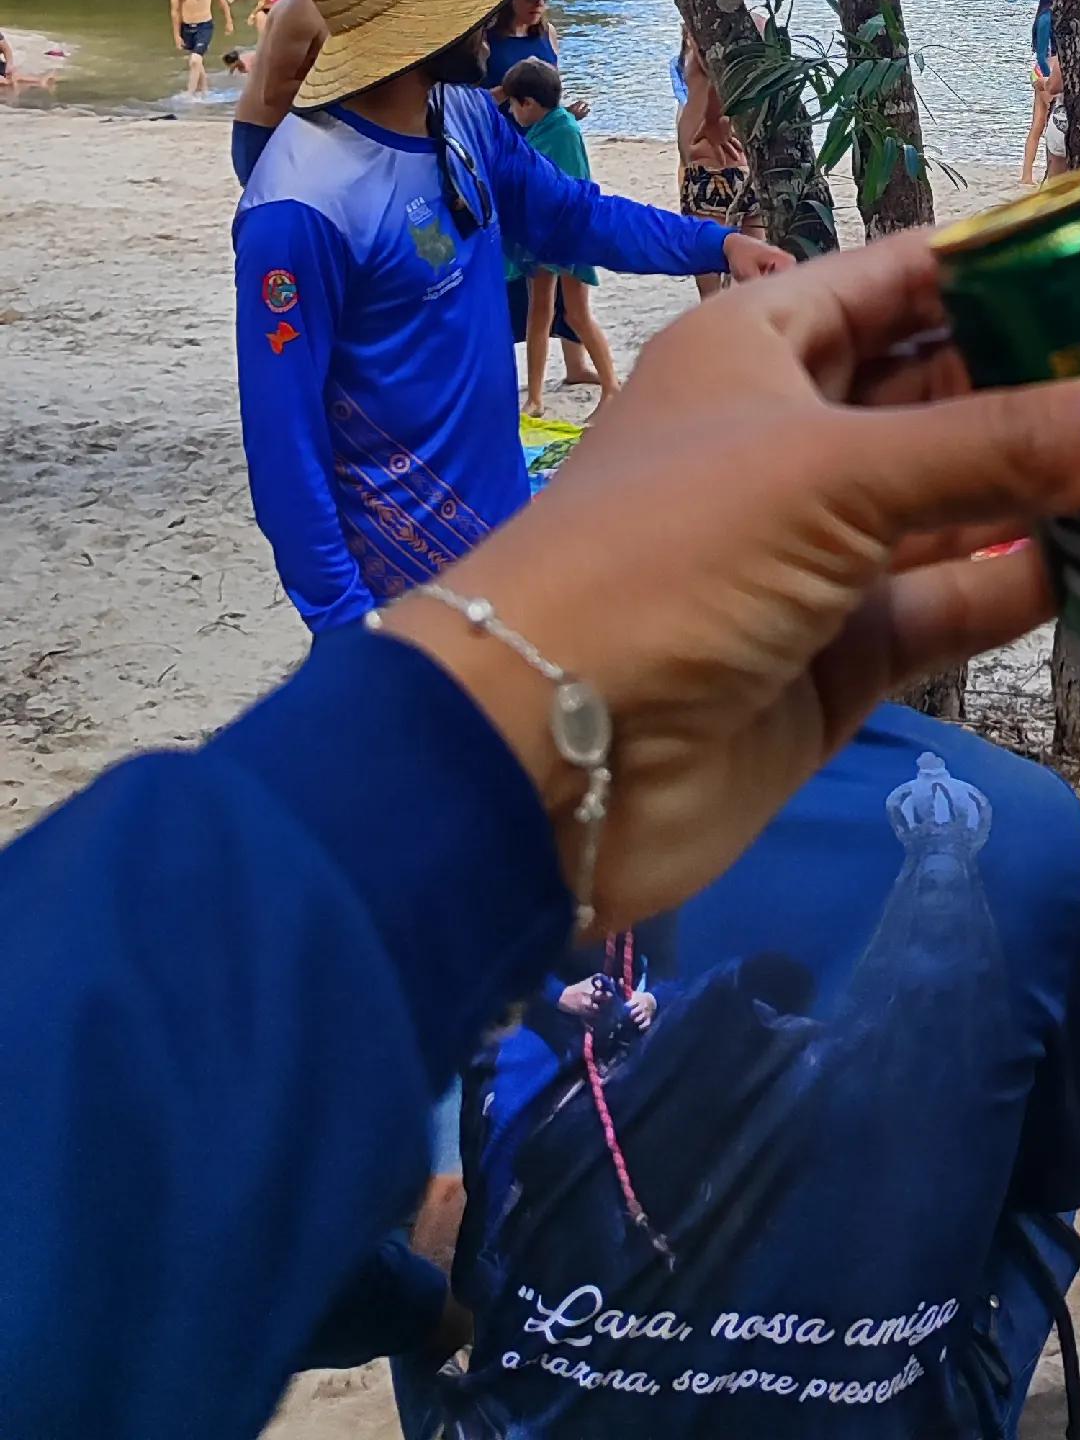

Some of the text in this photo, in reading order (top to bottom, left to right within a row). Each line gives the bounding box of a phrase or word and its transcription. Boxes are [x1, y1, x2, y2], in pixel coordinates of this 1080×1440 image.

[710, 1312, 836, 1345] nossa
[844, 1297, 960, 1347] amiga
[672, 1368, 800, 1395] sempre
